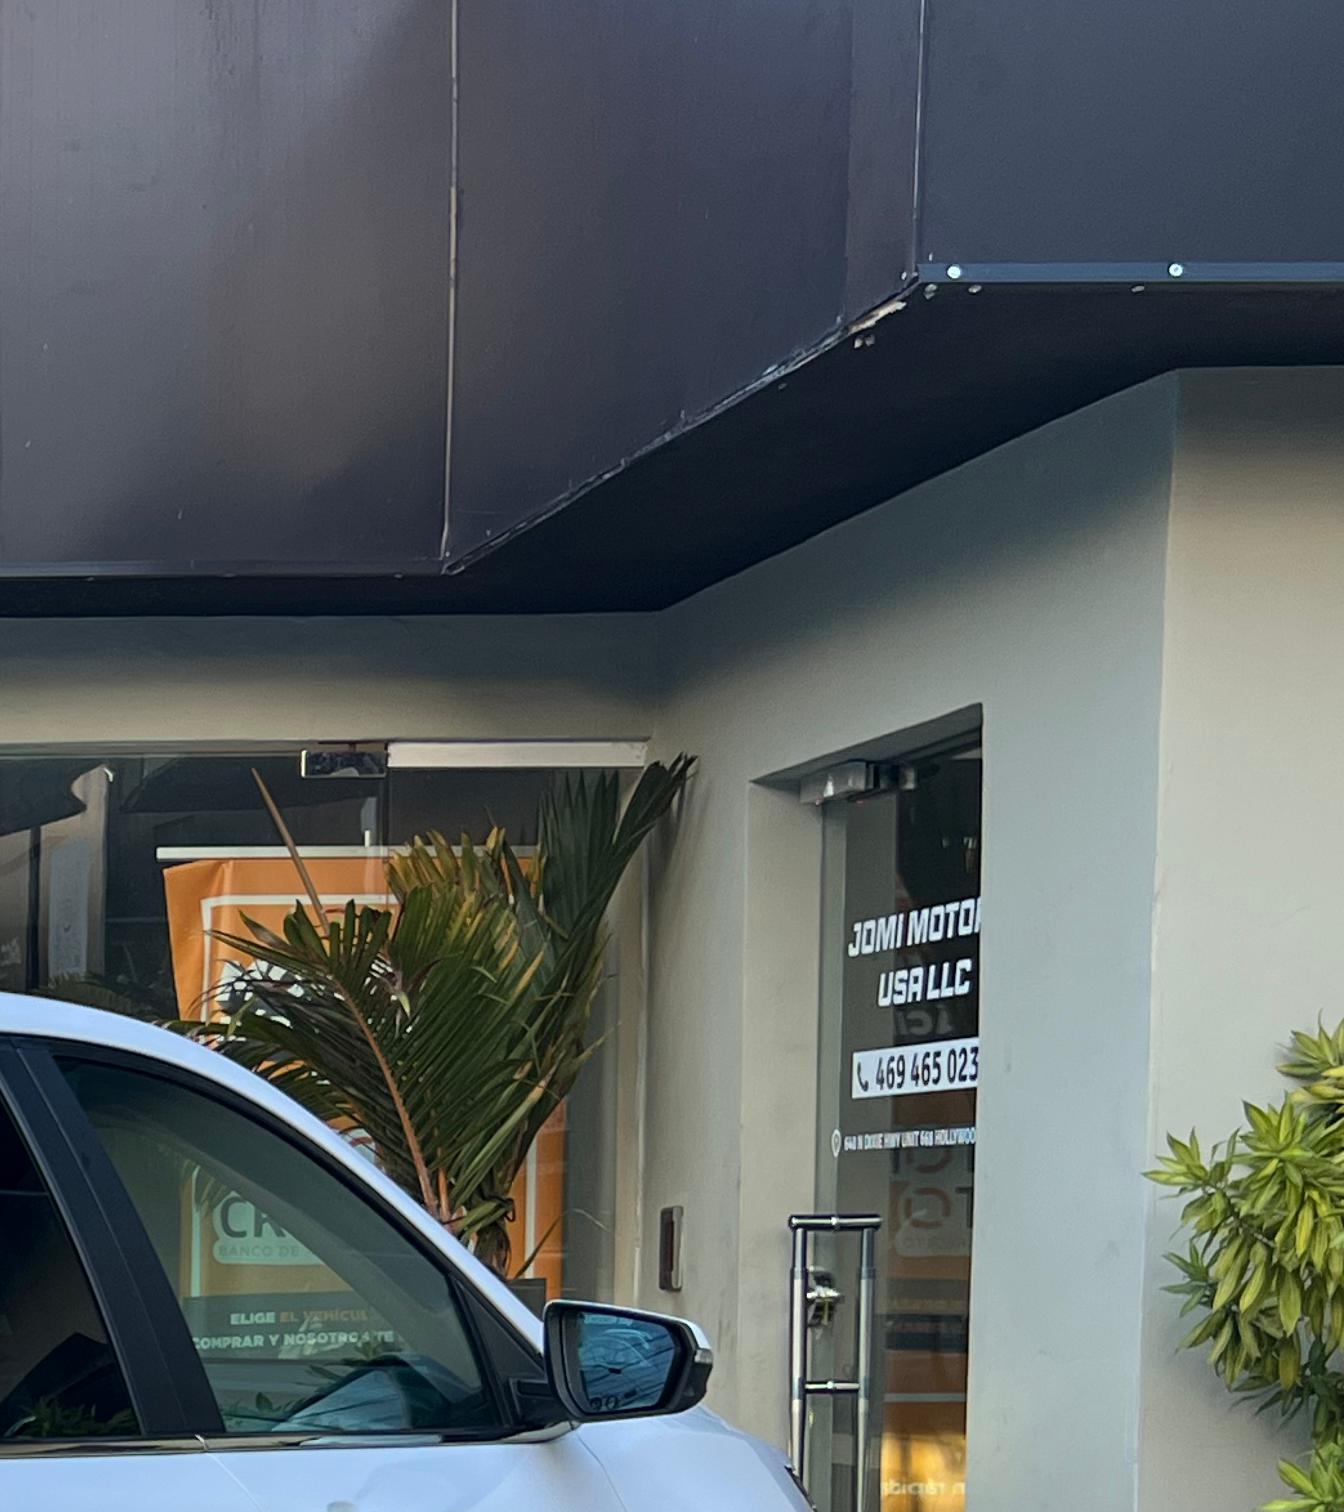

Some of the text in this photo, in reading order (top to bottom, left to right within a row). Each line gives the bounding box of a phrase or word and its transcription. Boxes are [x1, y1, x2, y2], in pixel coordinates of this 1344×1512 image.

[847, 911, 904, 957] JOMI
[877, 957, 973, 1007] USA LLC
[875, 1046, 979, 1091] 469 465 023
[229, 1308, 369, 1326] ELIGE EL VEHÍCUL
[268, 1334, 279, 1347] Y
